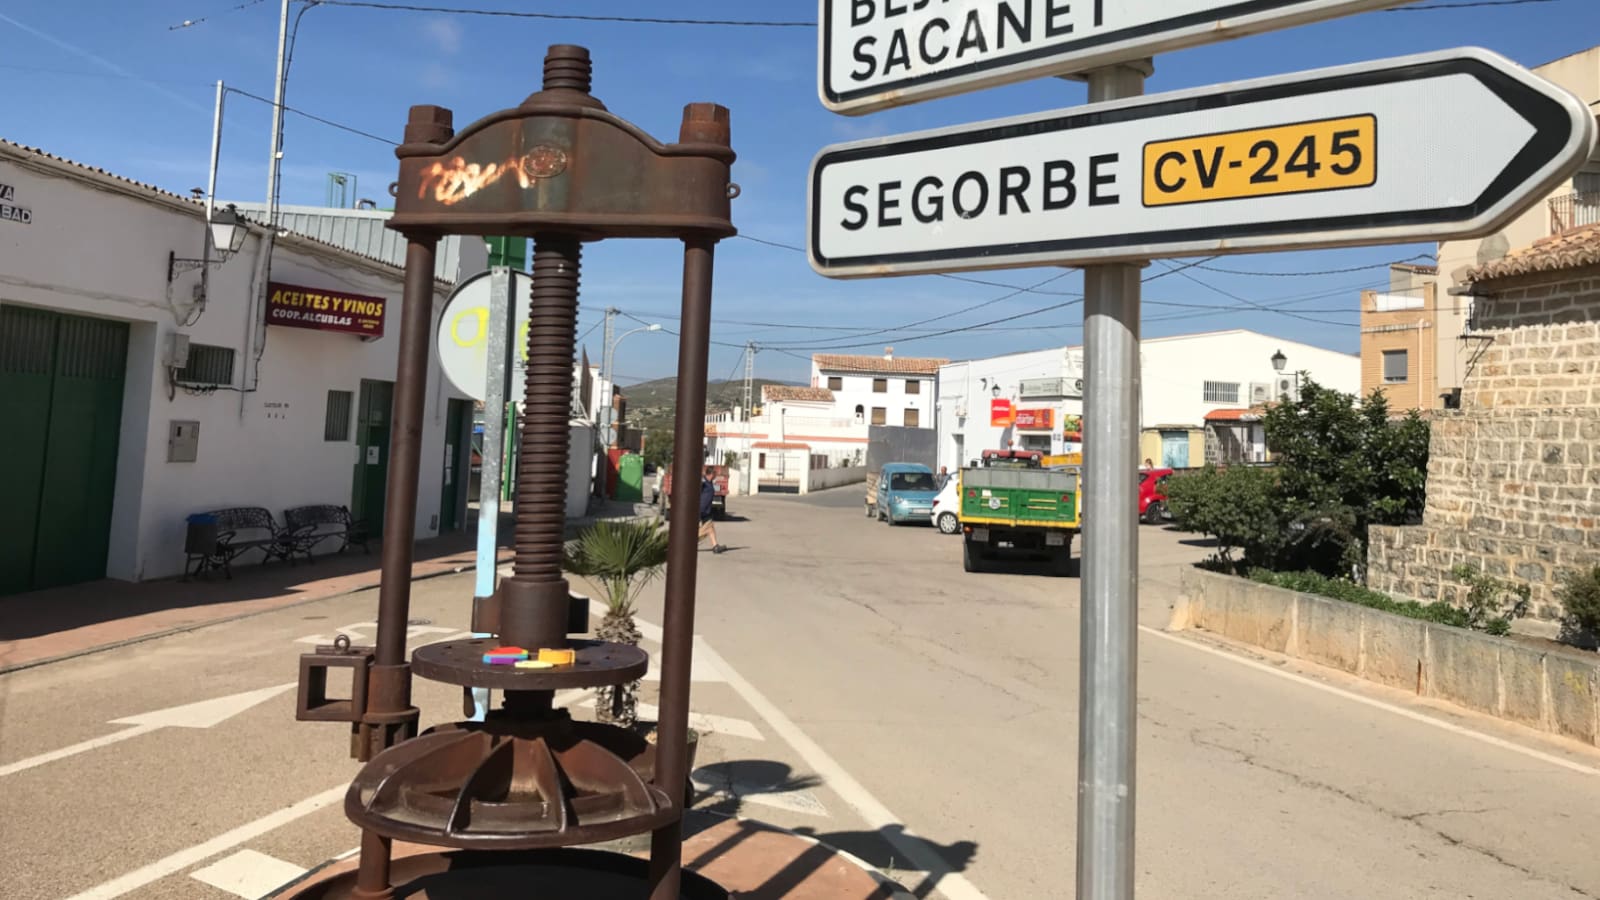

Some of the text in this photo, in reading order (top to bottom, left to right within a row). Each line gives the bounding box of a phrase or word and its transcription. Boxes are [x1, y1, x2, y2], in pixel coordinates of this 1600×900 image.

[840, 129, 1362, 231] SEGORBE CV-245
[271, 289, 382, 316] ACEITES Y VINOS
[302, 312, 352, 325] ALCUBLAS
